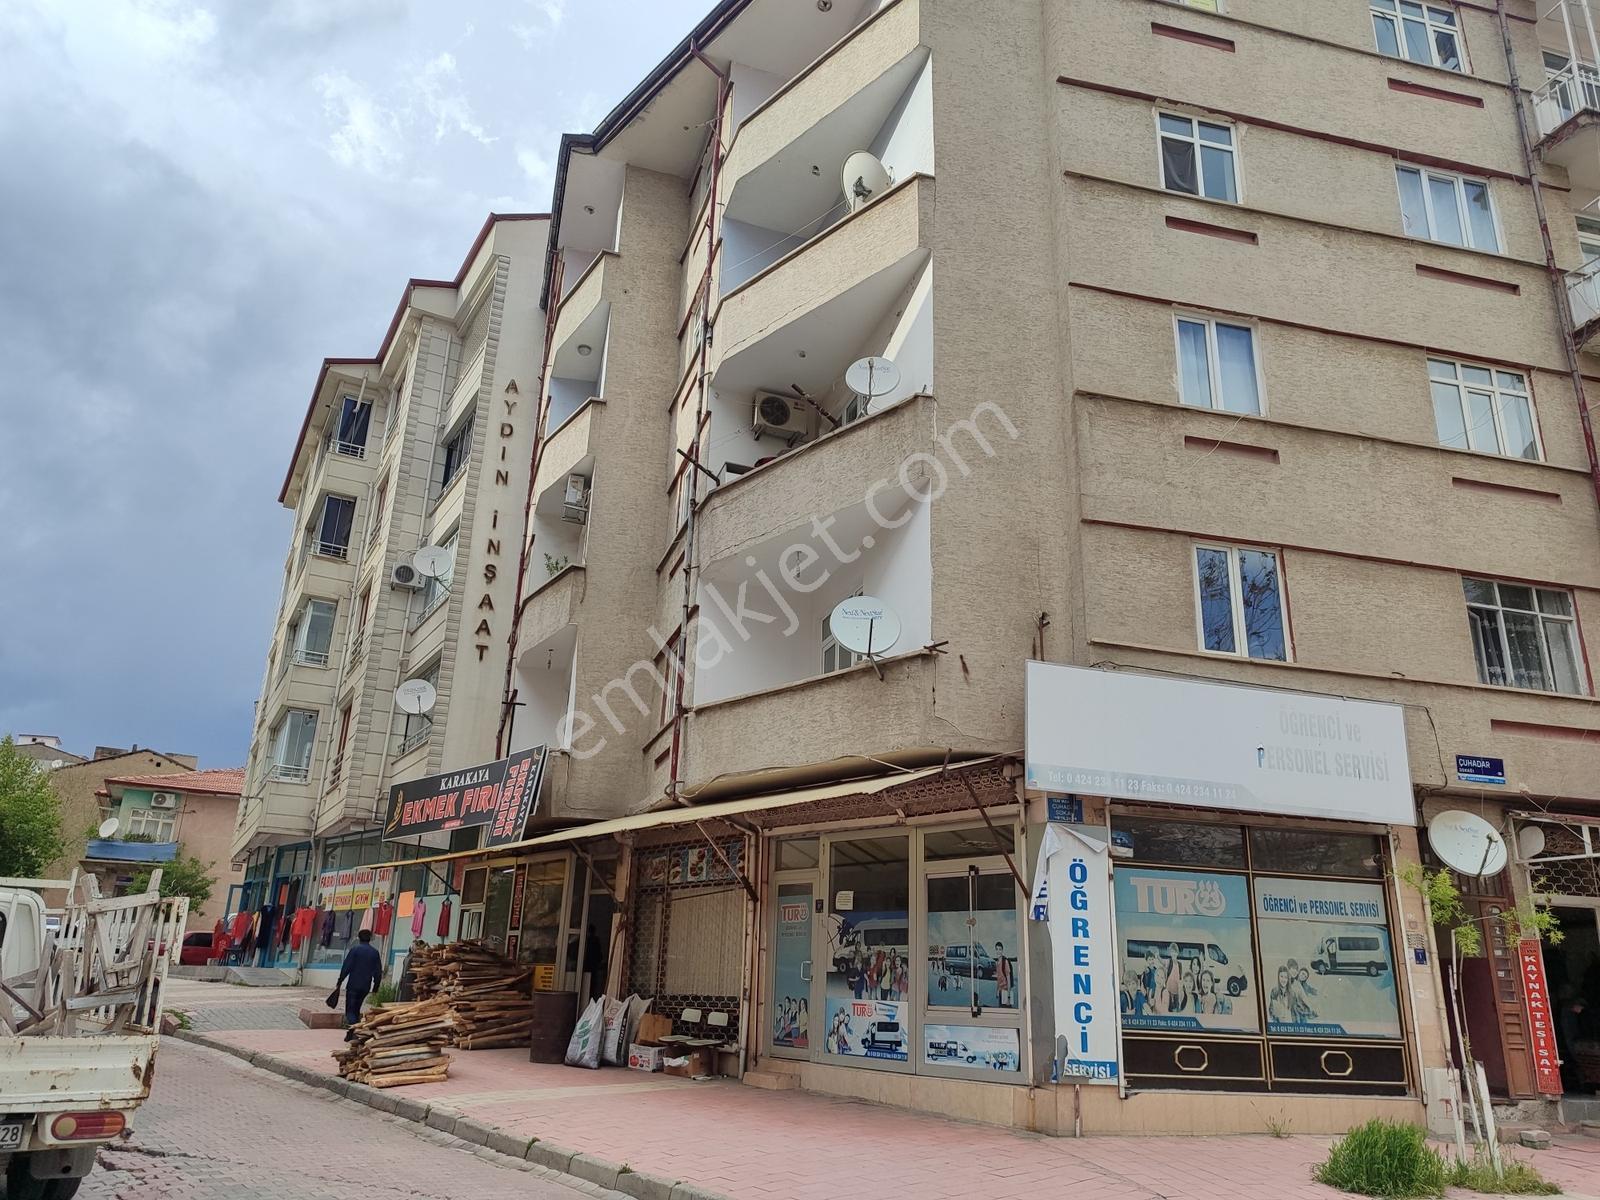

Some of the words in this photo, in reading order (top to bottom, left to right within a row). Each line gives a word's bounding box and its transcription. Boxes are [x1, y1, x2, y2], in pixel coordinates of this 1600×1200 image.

[494, 378, 519, 487] AYDIN
[475, 510, 501, 663] İNŞAAT
[1280, 704, 1342, 740] ÖĞRENCİ
[1345, 722, 1361, 742] ve
[439, 768, 490, 791] KARAKAYA
[1048, 769, 1064, 784] Tel:
[1066, 773, 1073, 784] 0
[1075, 774, 1092, 786] 424
[1127, 780, 1140, 791] 23
[1141, 780, 1165, 794] Faks:
[1166, 783, 1173, 794] 0
[1257, 745, 1331, 775] PERSONEL
[1335, 749, 1390, 782] SERVİSİ
[1458, 758, 1491, 769] ÇUHADAR
[401, 791, 459, 827] EKMEK
[460, 783, 501, 818] FIRI
[493, 764, 520, 837] FIRINI
[502, 758, 532, 838] EKMEK
[516, 764, 537, 826] KARAKAYA
[1263, 893, 1298, 913] ÖĞRENCİ
[1298, 903, 1309, 914] ve
[1309, 900, 1349, 916] PERSONEL
[1350, 900, 1380, 918] SERVİSİ
[1068, 858, 1093, 1054] ÖĞRENCİ
[1524, 955, 1544, 1008] KAYNAK
[1532, 1011, 1553, 1076] TESİSAT
[1064, 1063, 1111, 1079] SERVİSİ
[0, 1126, 19, 1142] 28
